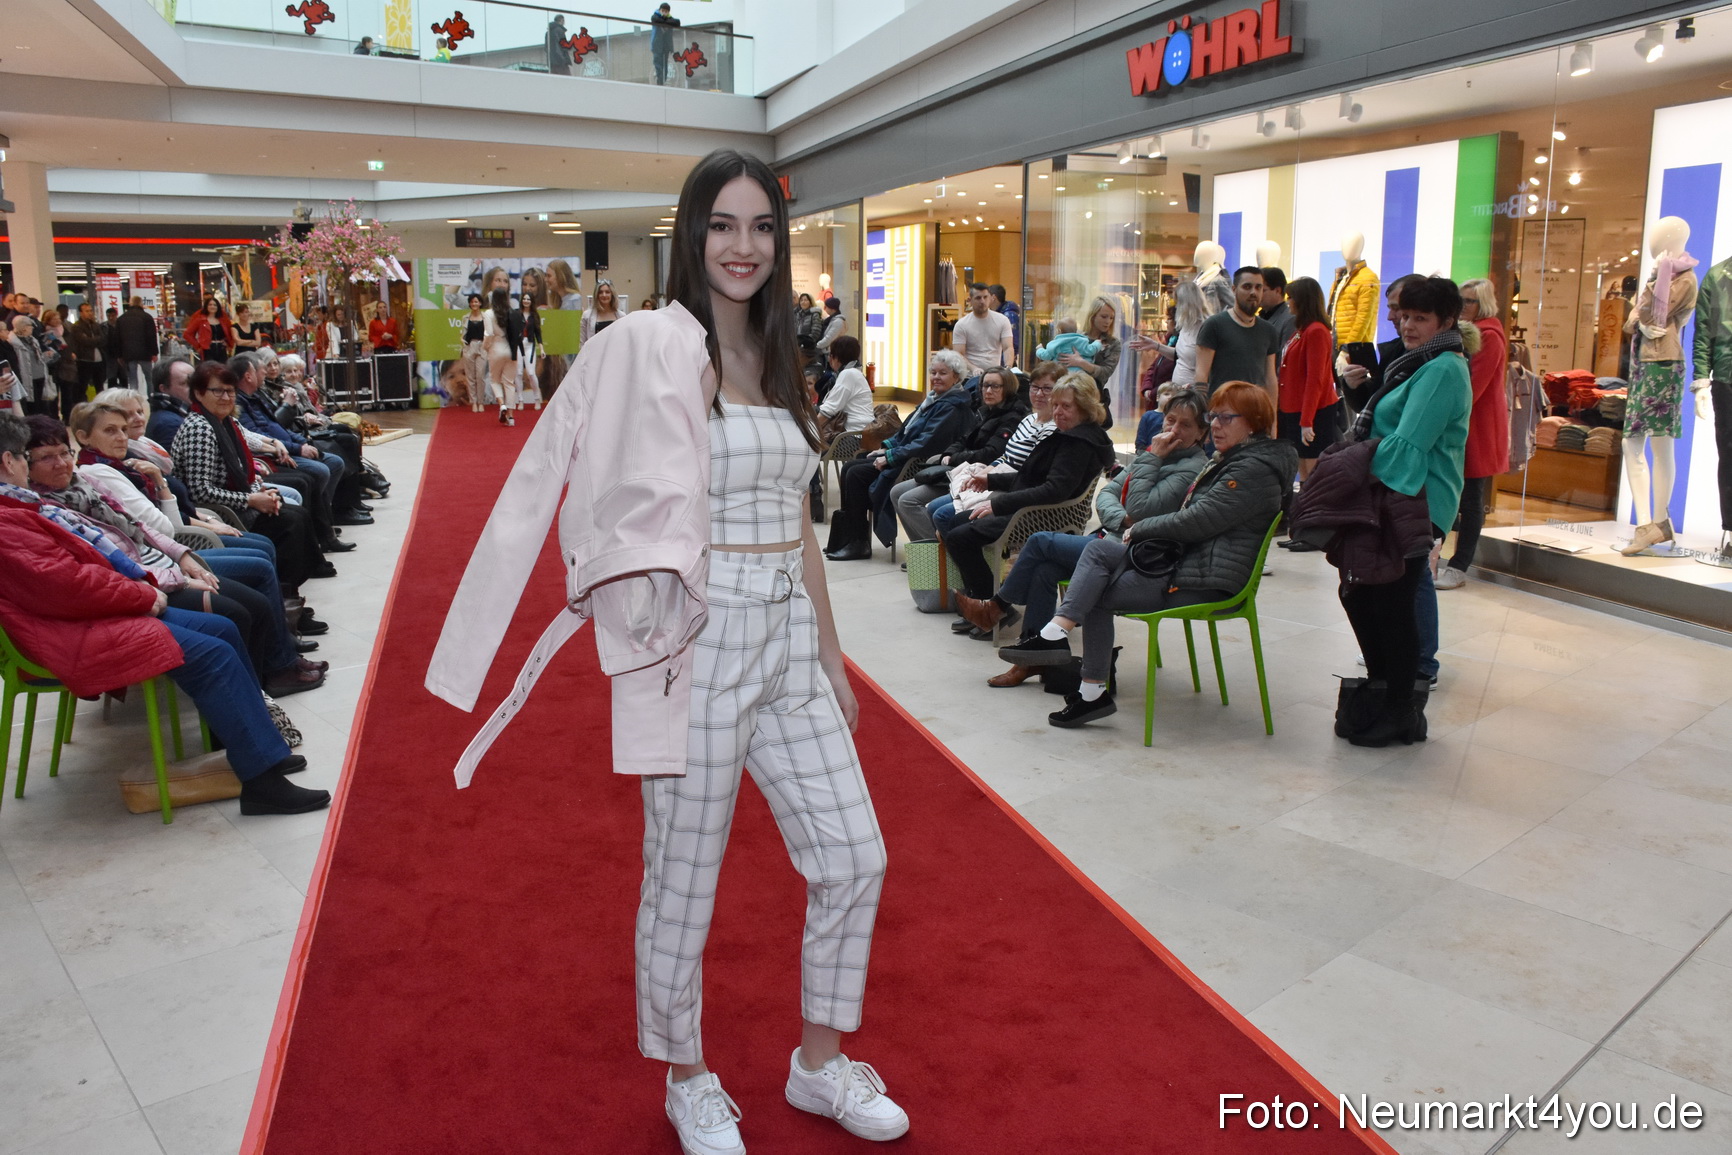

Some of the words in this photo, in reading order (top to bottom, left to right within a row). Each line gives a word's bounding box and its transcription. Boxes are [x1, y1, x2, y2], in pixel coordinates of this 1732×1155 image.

[1126, 0, 1293, 97] WÖHRL
[1576, 524, 1594, 536] JUNE
[1677, 547, 1707, 560] GERRY
